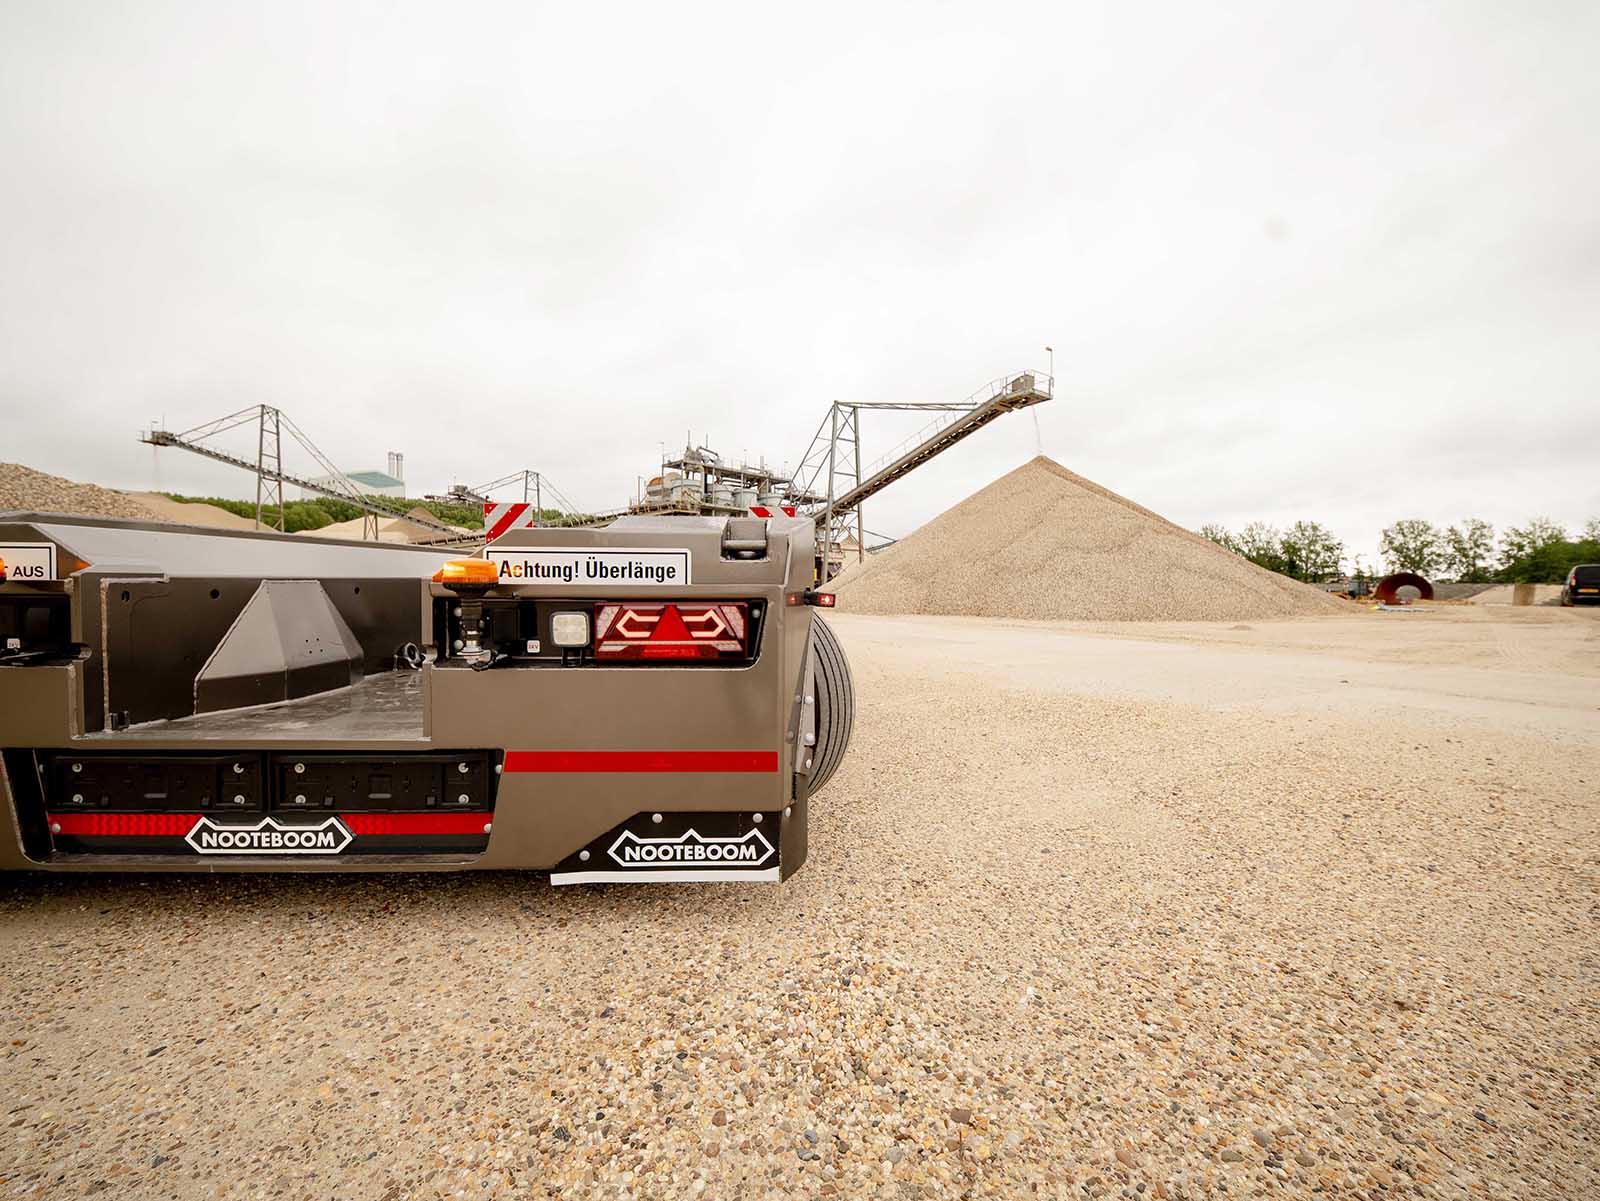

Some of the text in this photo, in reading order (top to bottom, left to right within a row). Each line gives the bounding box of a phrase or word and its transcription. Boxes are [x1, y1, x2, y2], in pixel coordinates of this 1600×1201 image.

[12, 566, 44, 577] AUS
[499, 556, 676, 582] Achtung! Überlänge
[201, 831, 335, 848] NOOTEBOOM
[624, 844, 757, 861] NOOTEBOOM
